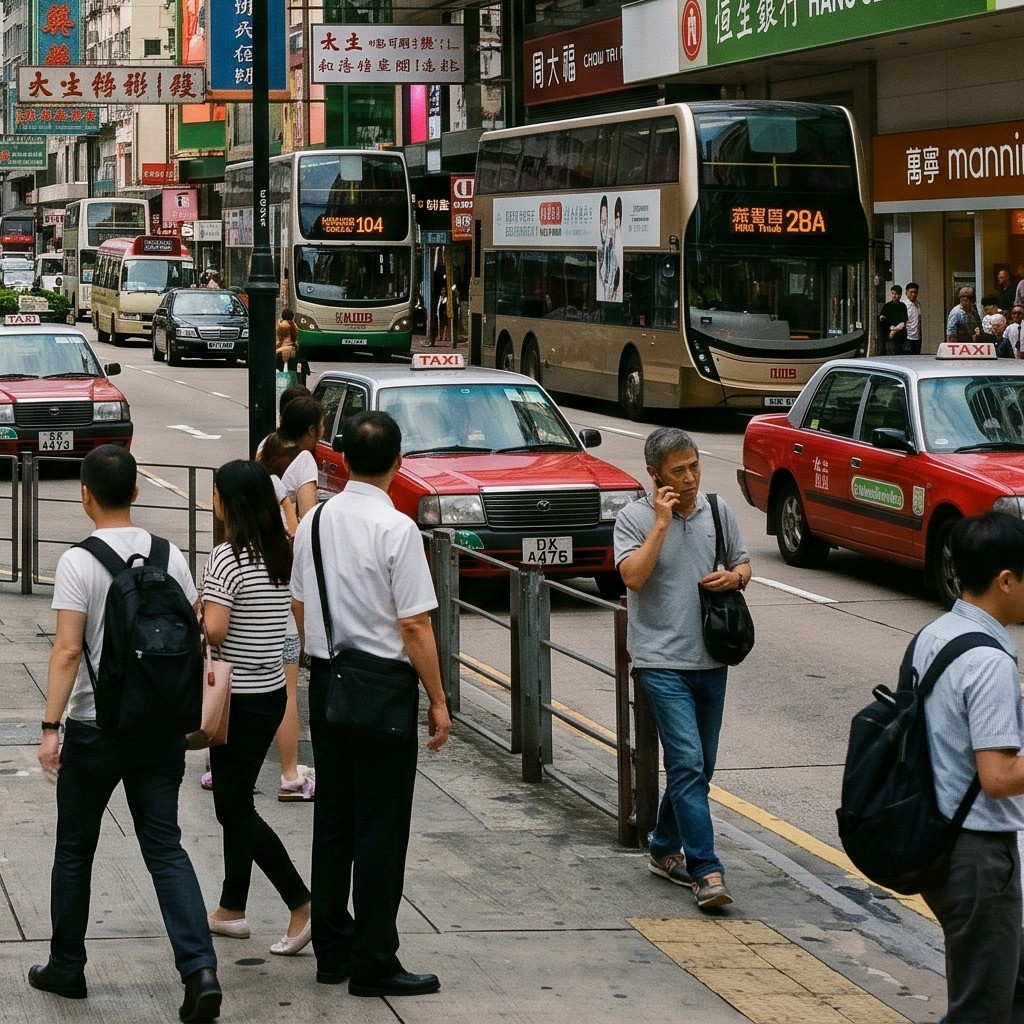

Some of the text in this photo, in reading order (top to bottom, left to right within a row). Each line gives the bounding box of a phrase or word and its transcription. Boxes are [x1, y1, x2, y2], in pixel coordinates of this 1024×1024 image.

[533, 43, 576, 89] 周大福
[583, 50, 604, 68] CHOW
[906, 131, 1024, 185] 萬寧 manni
[356, 216, 384, 233] 104
[948, 344, 991, 356] TAXI
[419, 355, 459, 366] TAXI
[537, 538, 558, 551] DX
